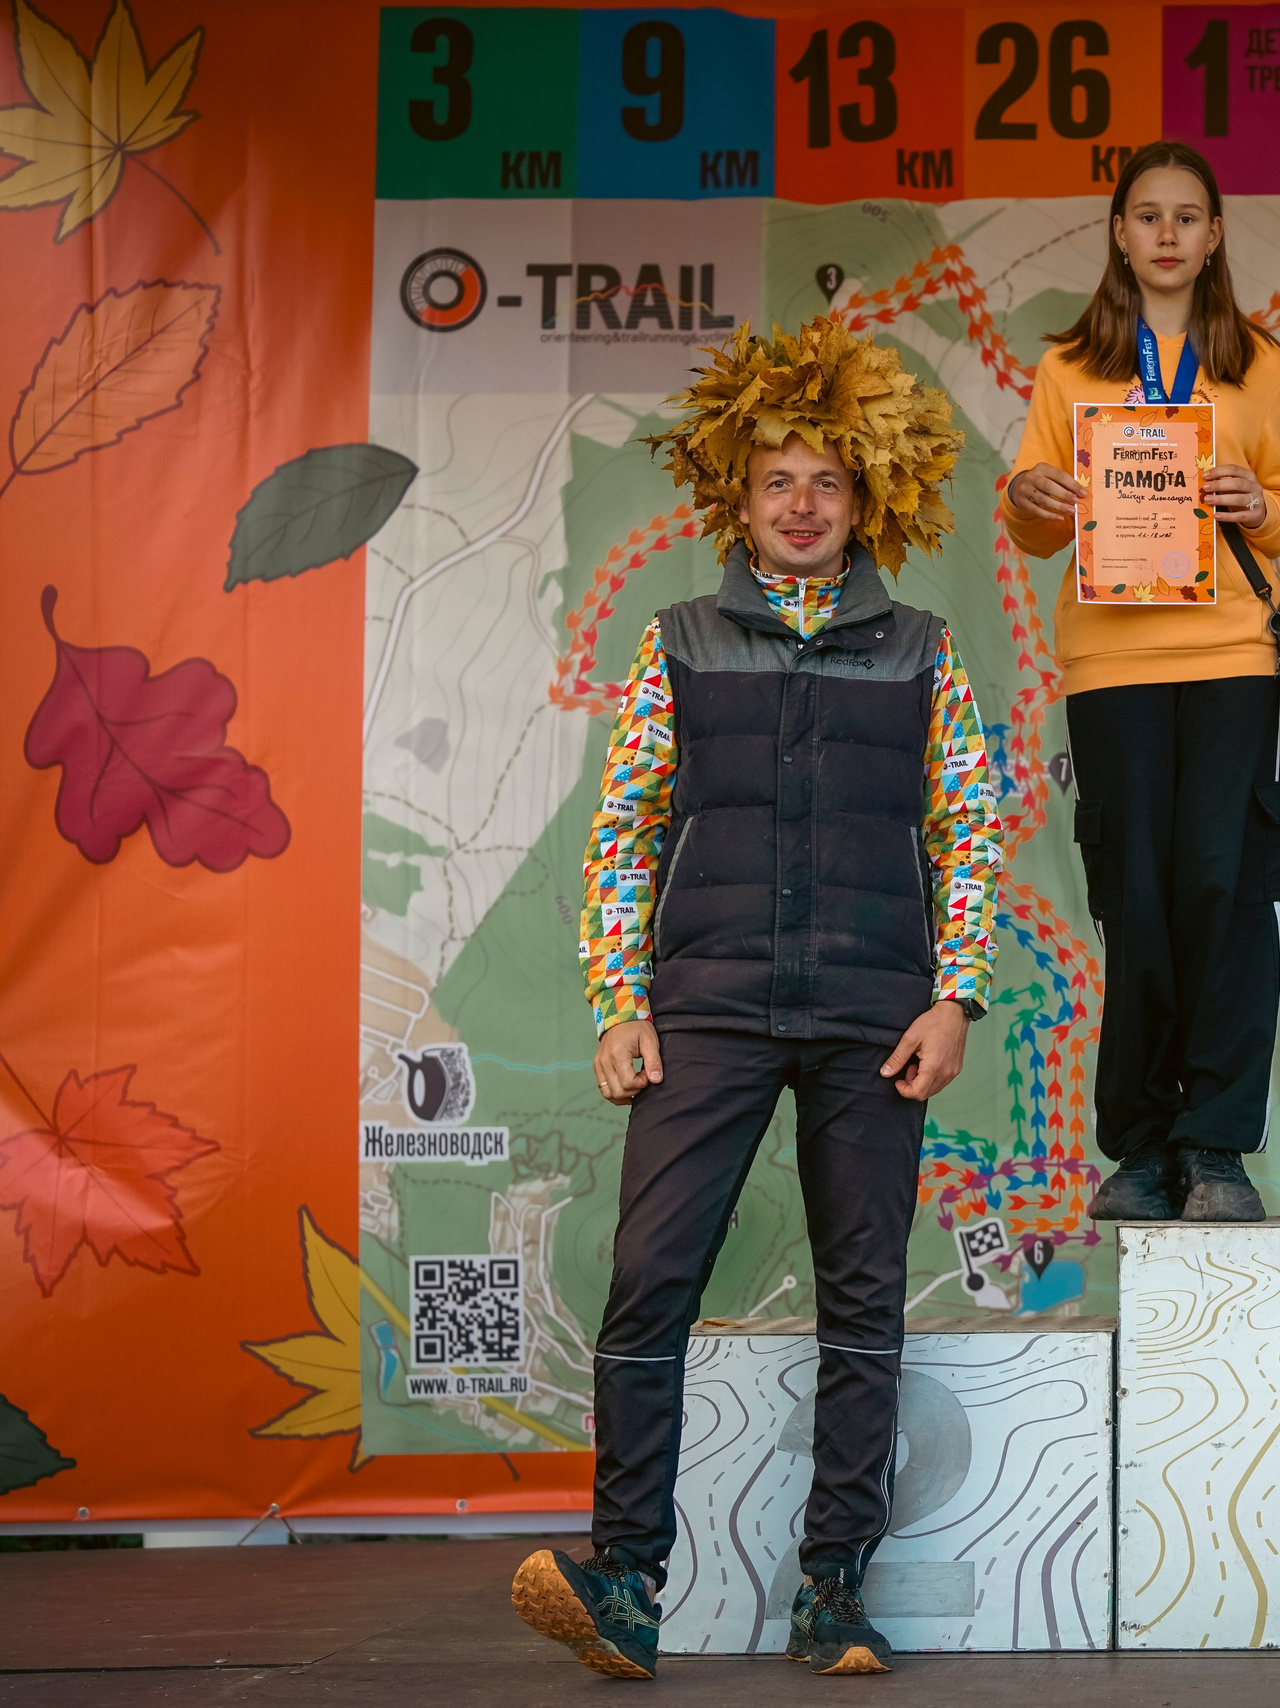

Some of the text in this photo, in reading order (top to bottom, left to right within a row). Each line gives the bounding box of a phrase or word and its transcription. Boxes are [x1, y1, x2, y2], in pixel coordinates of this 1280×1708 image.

[975, 19, 1110, 141] 26
[1184, 19, 1229, 138] 1
[408, 18, 561, 190] 3 КМ
[621, 20, 759, 189] 9 КМ
[788, 20, 954, 189] 13 КМ
[825, 267, 837, 289] 3
[1104, 468, 1187, 492] ГРАМОТА
[1152, 522, 1159, 530] 9
[364, 1126, 505, 1161] Железноводск
[1033, 1242, 1044, 1264] 6
[410, 1376, 528, 1394] WWW. O-TRAIL.RU
